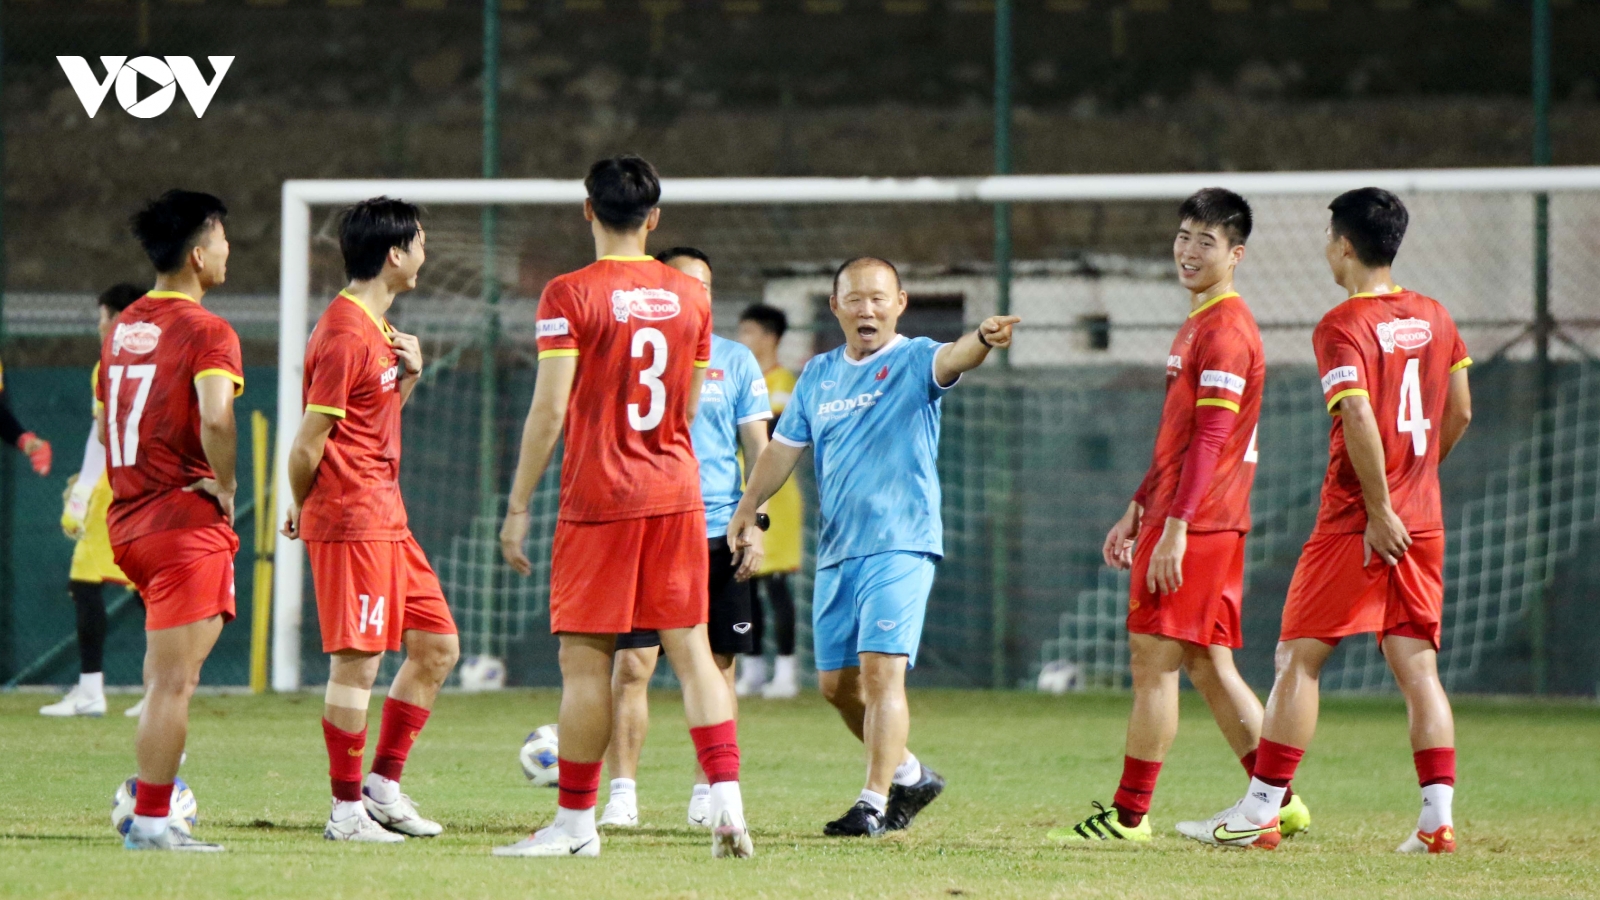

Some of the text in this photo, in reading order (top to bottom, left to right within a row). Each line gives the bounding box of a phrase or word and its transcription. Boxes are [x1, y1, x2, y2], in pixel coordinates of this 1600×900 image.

[108, 364, 157, 468] 17
[628, 327, 668, 431] 3
[1397, 358, 1431, 456] 4
[359, 594, 385, 636] 14
